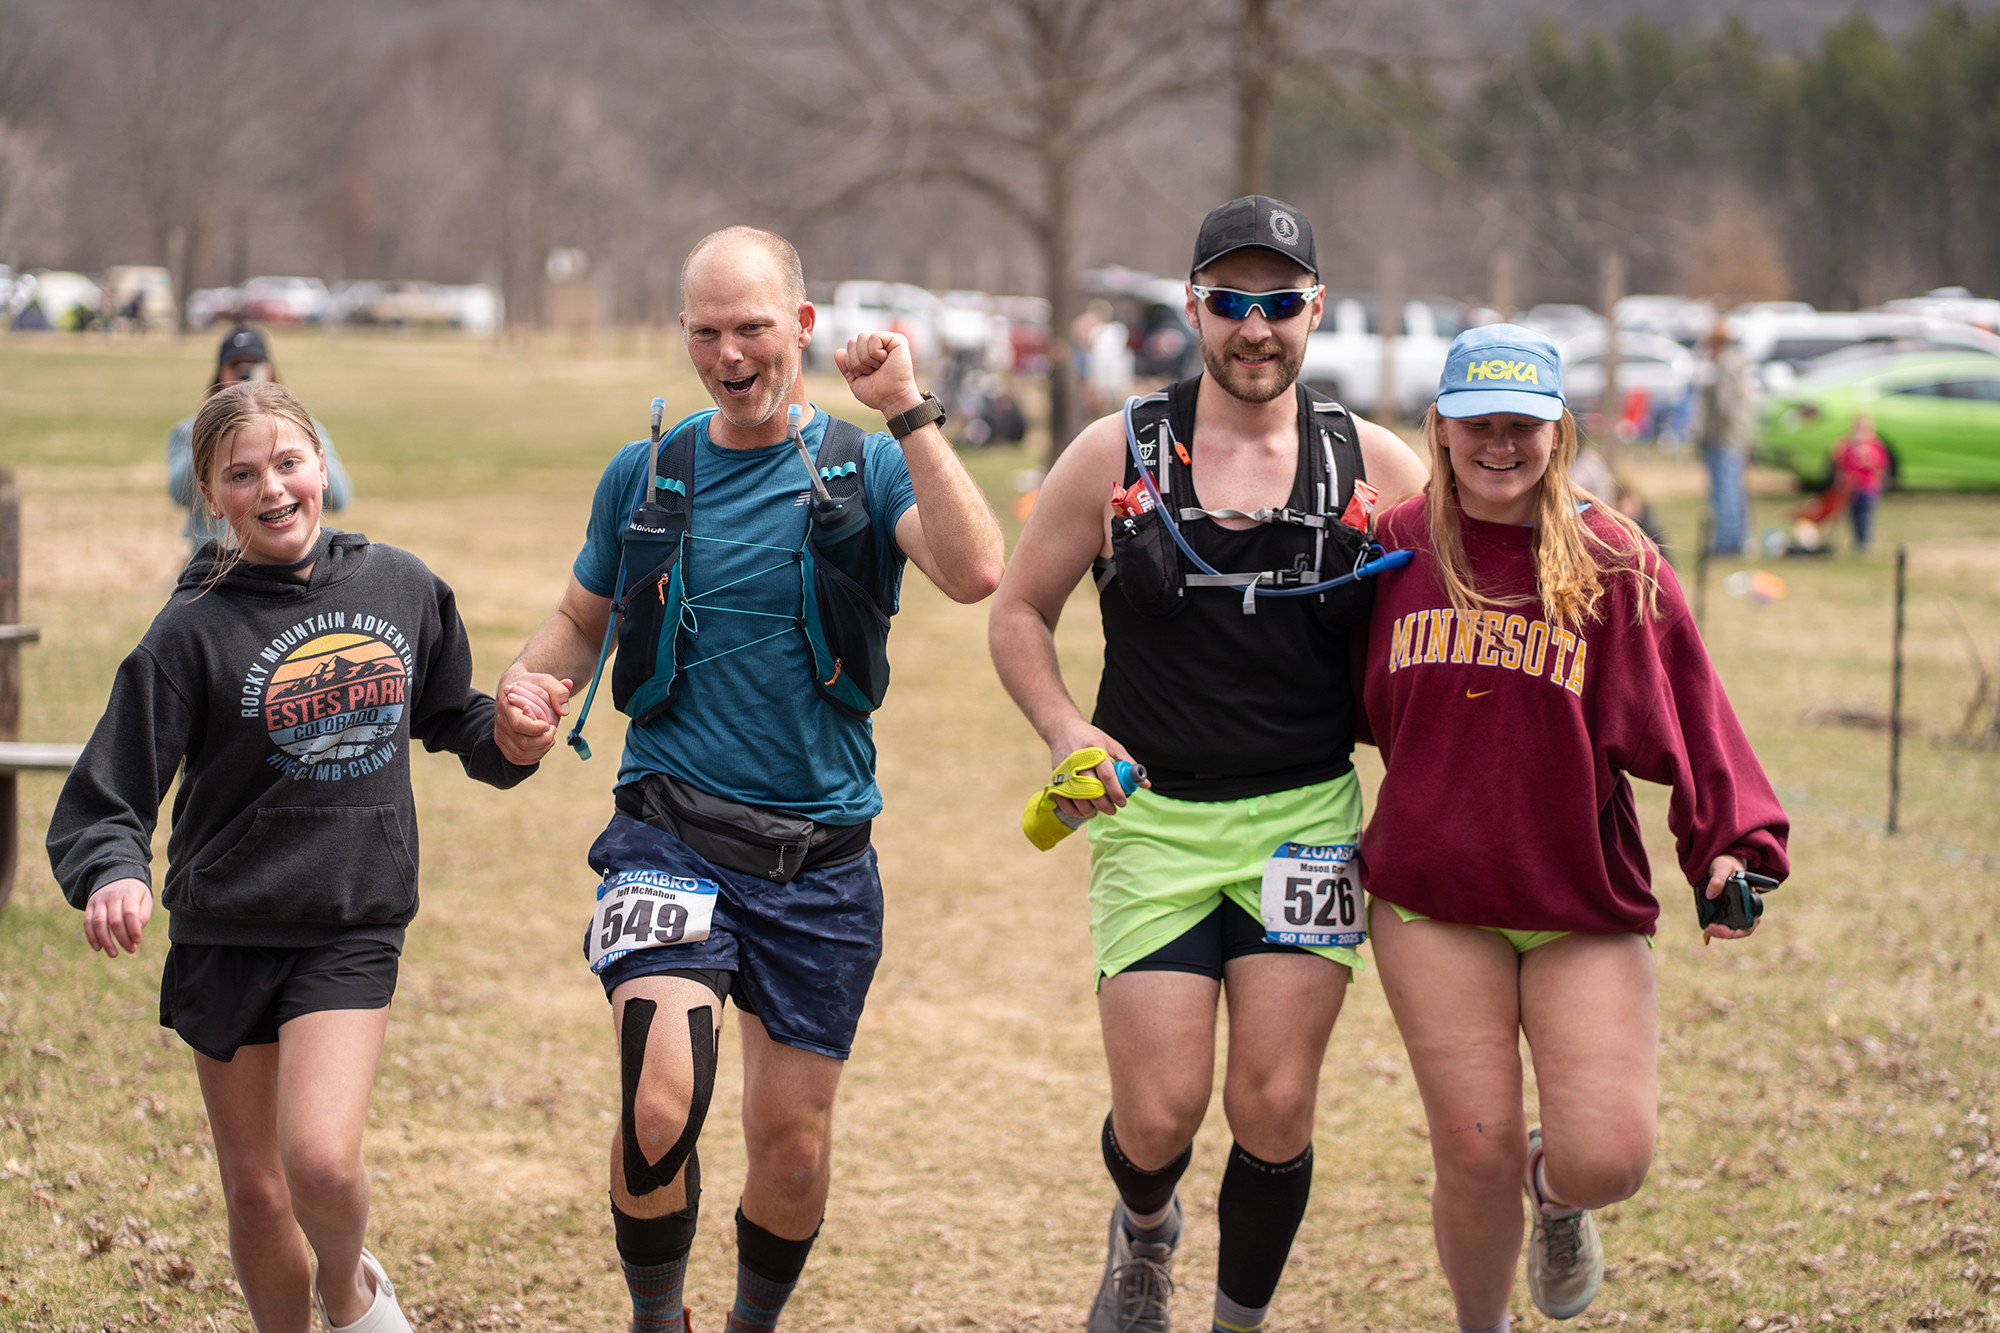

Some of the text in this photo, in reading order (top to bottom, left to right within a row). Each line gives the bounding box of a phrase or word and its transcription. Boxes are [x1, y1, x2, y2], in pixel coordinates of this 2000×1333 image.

[1466, 360, 1539, 385] HOKA
[629, 522, 666, 533] ALOMON
[241, 611, 413, 718] ROCKY MOUNTAIN ADVENTURE
[1389, 608, 1588, 698] MINNESOTA
[265, 676, 406, 732] ESTES PARK
[294, 708, 379, 740] COLORADO
[348, 741, 399, 778] CRAWL
[616, 870, 699, 891] ZUMBRO
[1300, 863, 1329, 873] Mason
[616, 886, 676, 900] Jeff McMahon
[1284, 877, 1355, 926] 526
[601, 899, 688, 949] 549
[1280, 933, 1296, 943] 50
[1299, 934, 1330, 945] MILE
[1337, 933, 1359, 944] 2025
